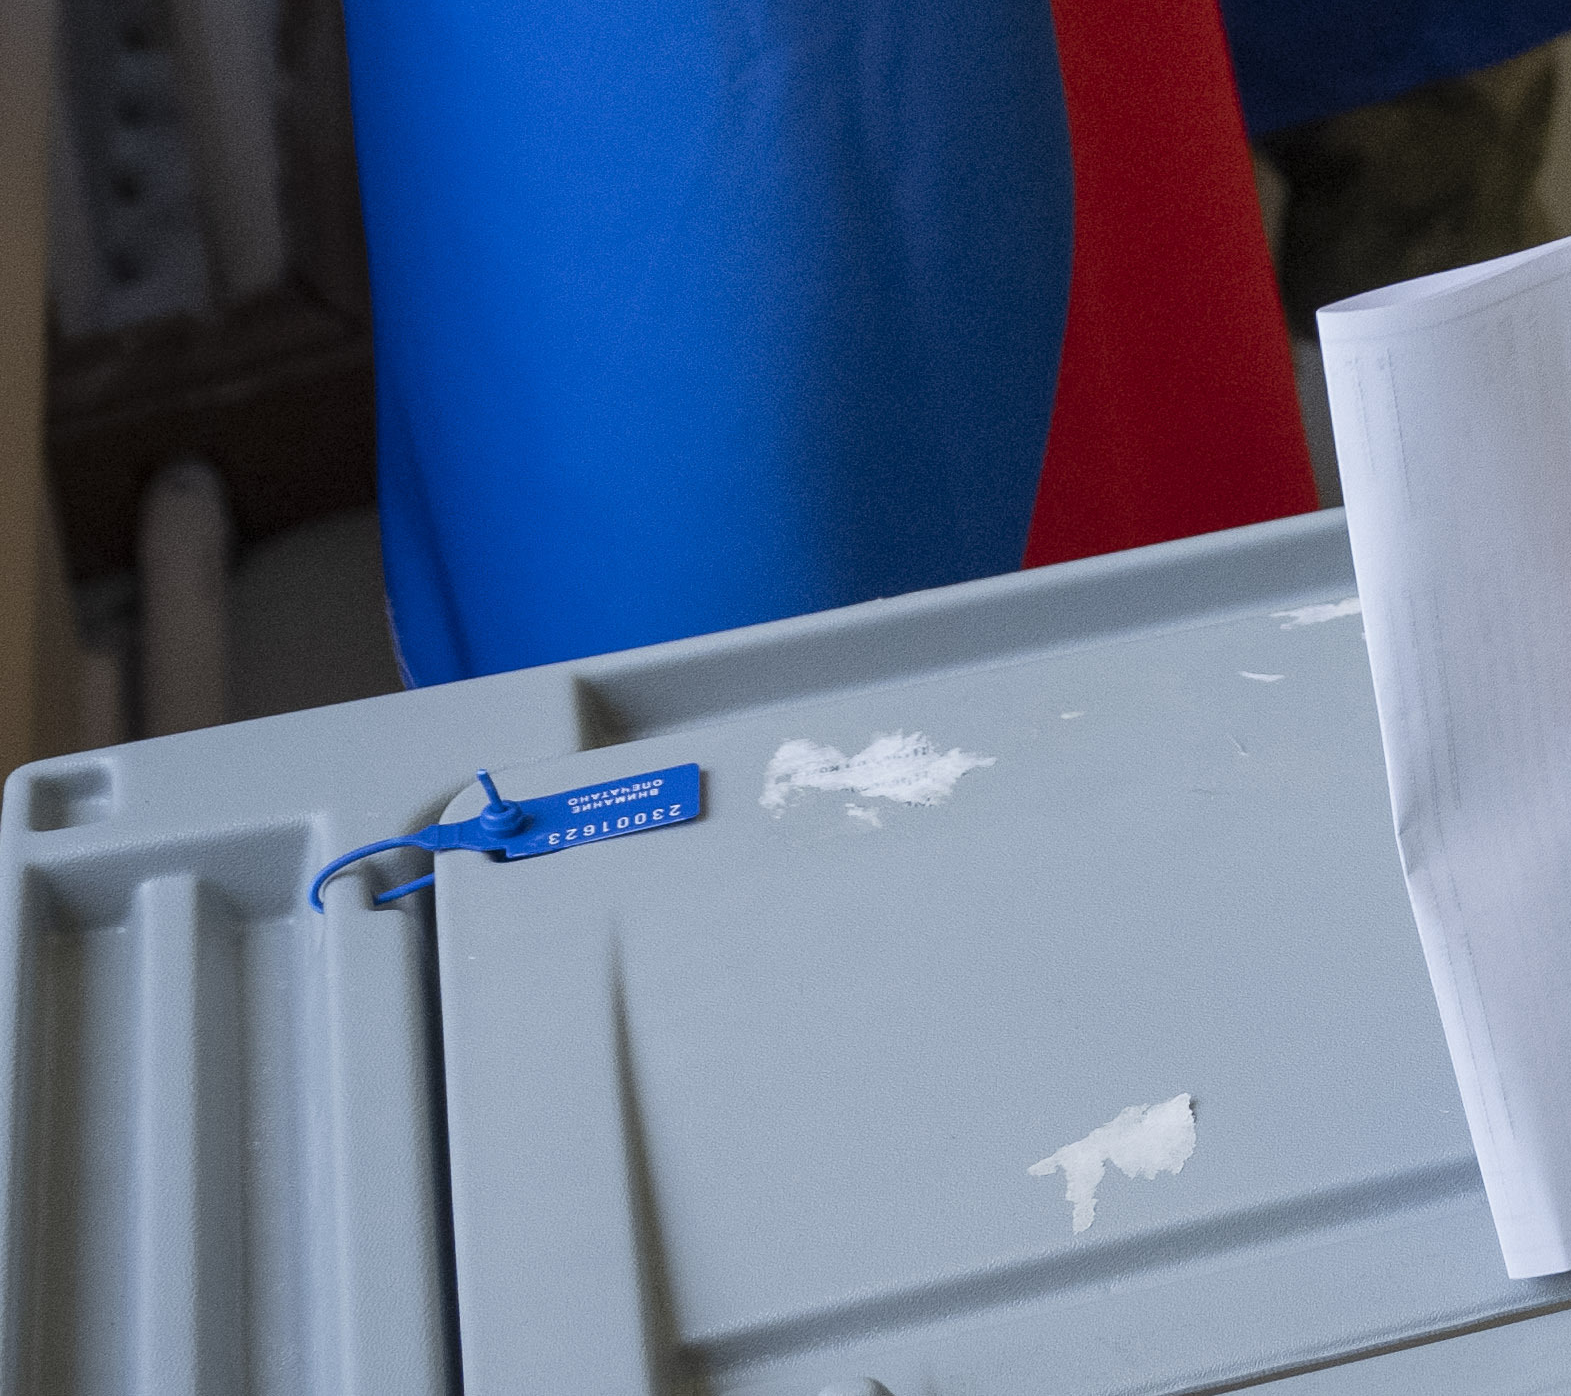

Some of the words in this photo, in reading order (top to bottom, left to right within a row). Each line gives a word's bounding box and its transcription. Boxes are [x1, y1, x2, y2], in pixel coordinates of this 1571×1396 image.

[567, 778, 663, 806] ОПЕЧАТАНО
[571, 788, 659, 814] ВНИМАНИЕ
[548, 804, 682, 845] 23001623
